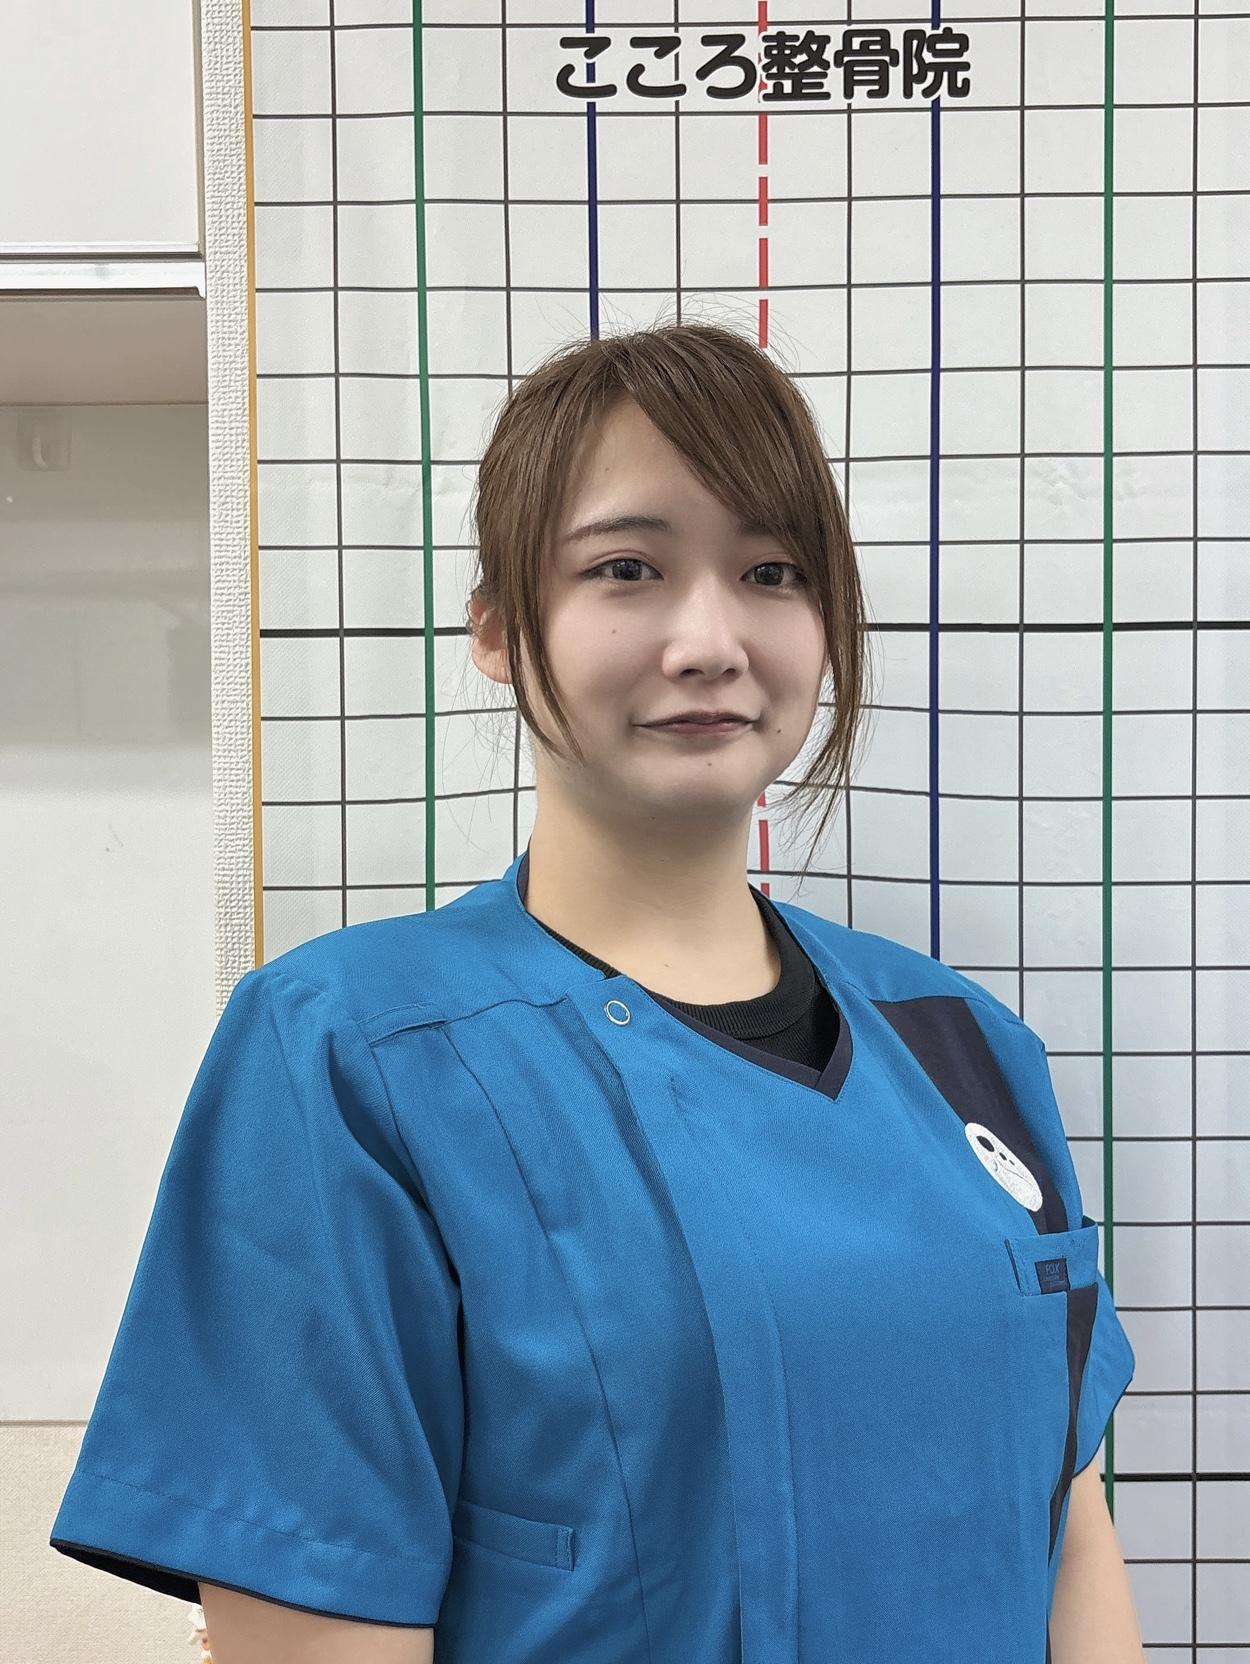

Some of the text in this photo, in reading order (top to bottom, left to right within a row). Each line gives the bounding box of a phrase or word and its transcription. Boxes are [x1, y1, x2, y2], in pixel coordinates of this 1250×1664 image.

[556, 27, 971, 101] こころ整骨院
